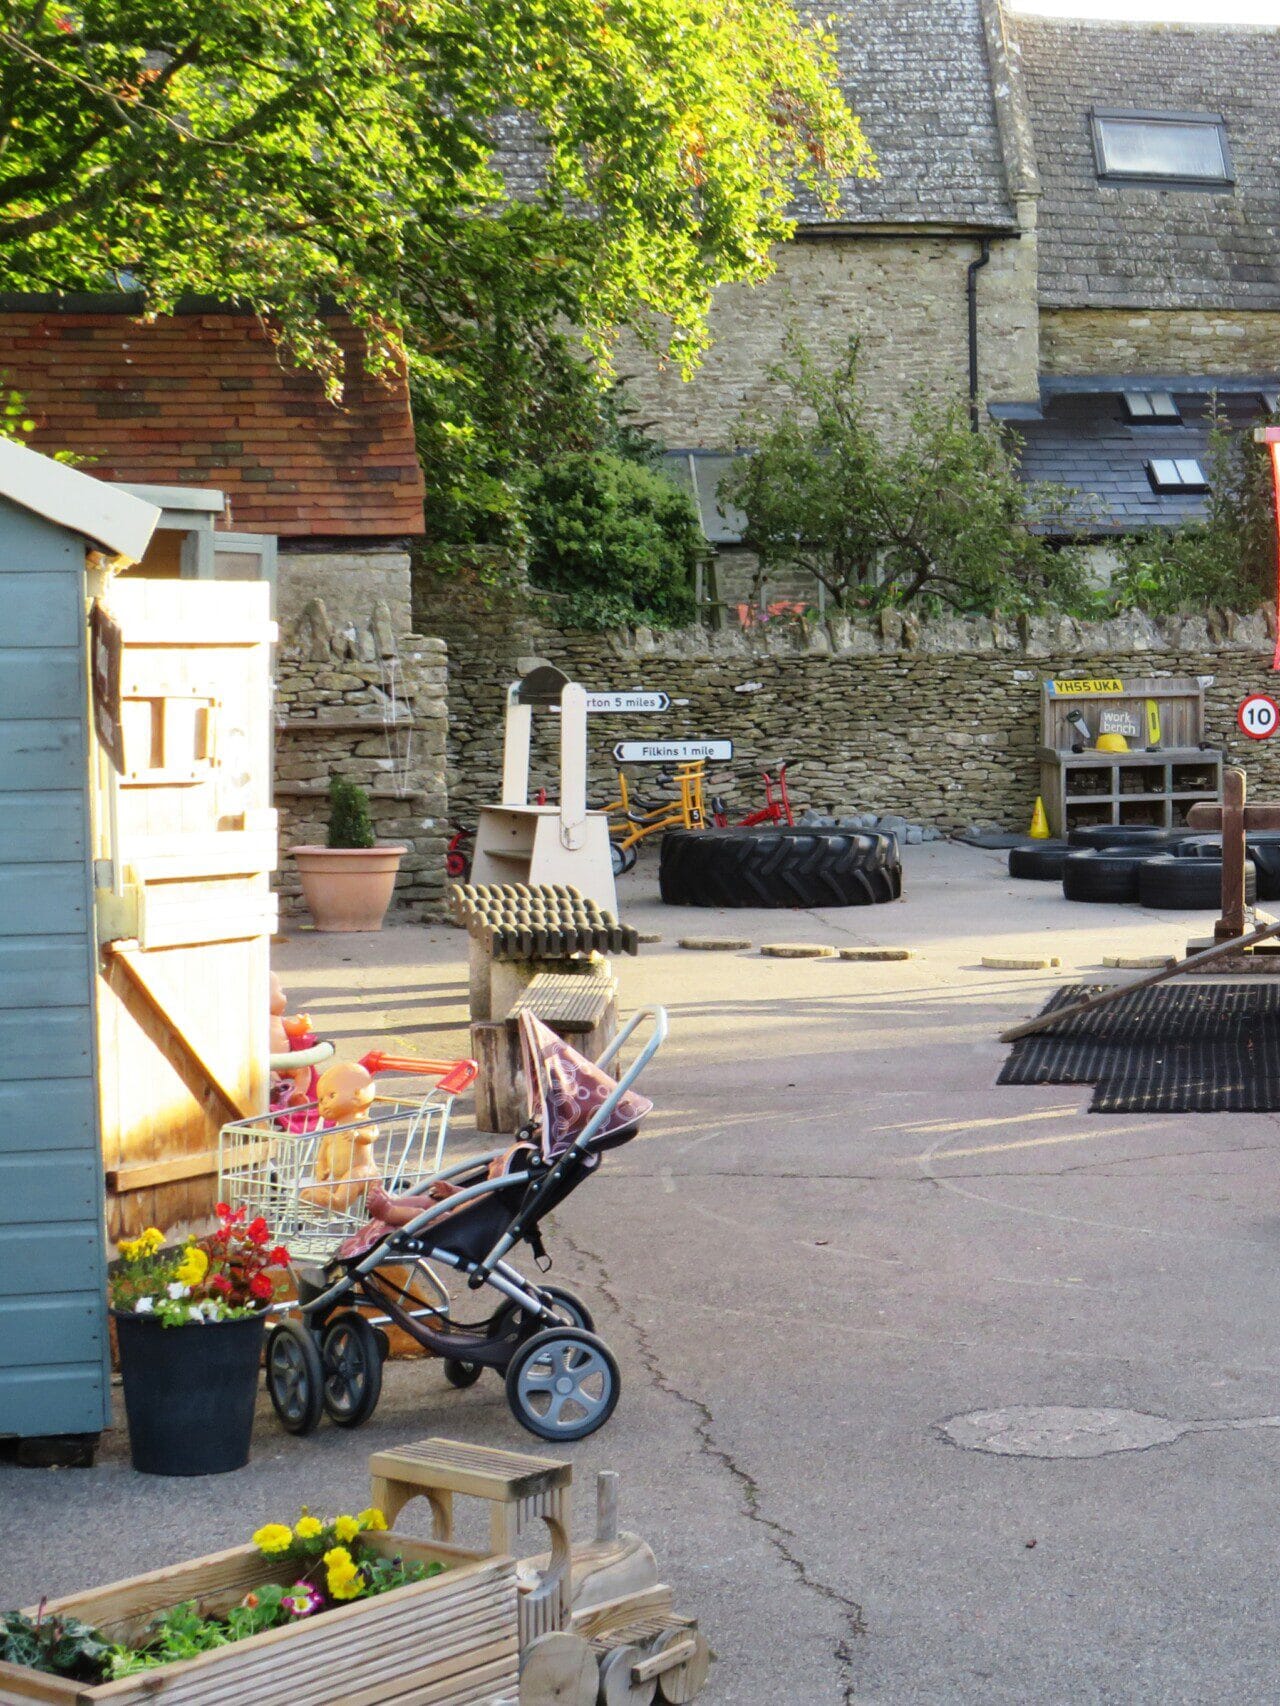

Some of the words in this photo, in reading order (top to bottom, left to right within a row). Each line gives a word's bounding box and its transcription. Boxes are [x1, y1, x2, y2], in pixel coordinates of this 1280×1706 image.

[1093, 681, 1121, 692] UKA
[586, 697, 610, 707] rton
[615, 697, 622, 707] 5
[626, 697, 656, 707] miles
[1103, 711, 1131, 723] work
[1247, 707, 1272, 726] 10
[1103, 720, 1136, 735] bench
[642, 746, 680, 756] Filkins
[682, 746, 688, 756] 1
[691, 746, 715, 756] mile
[693, 809, 700, 820] 5
